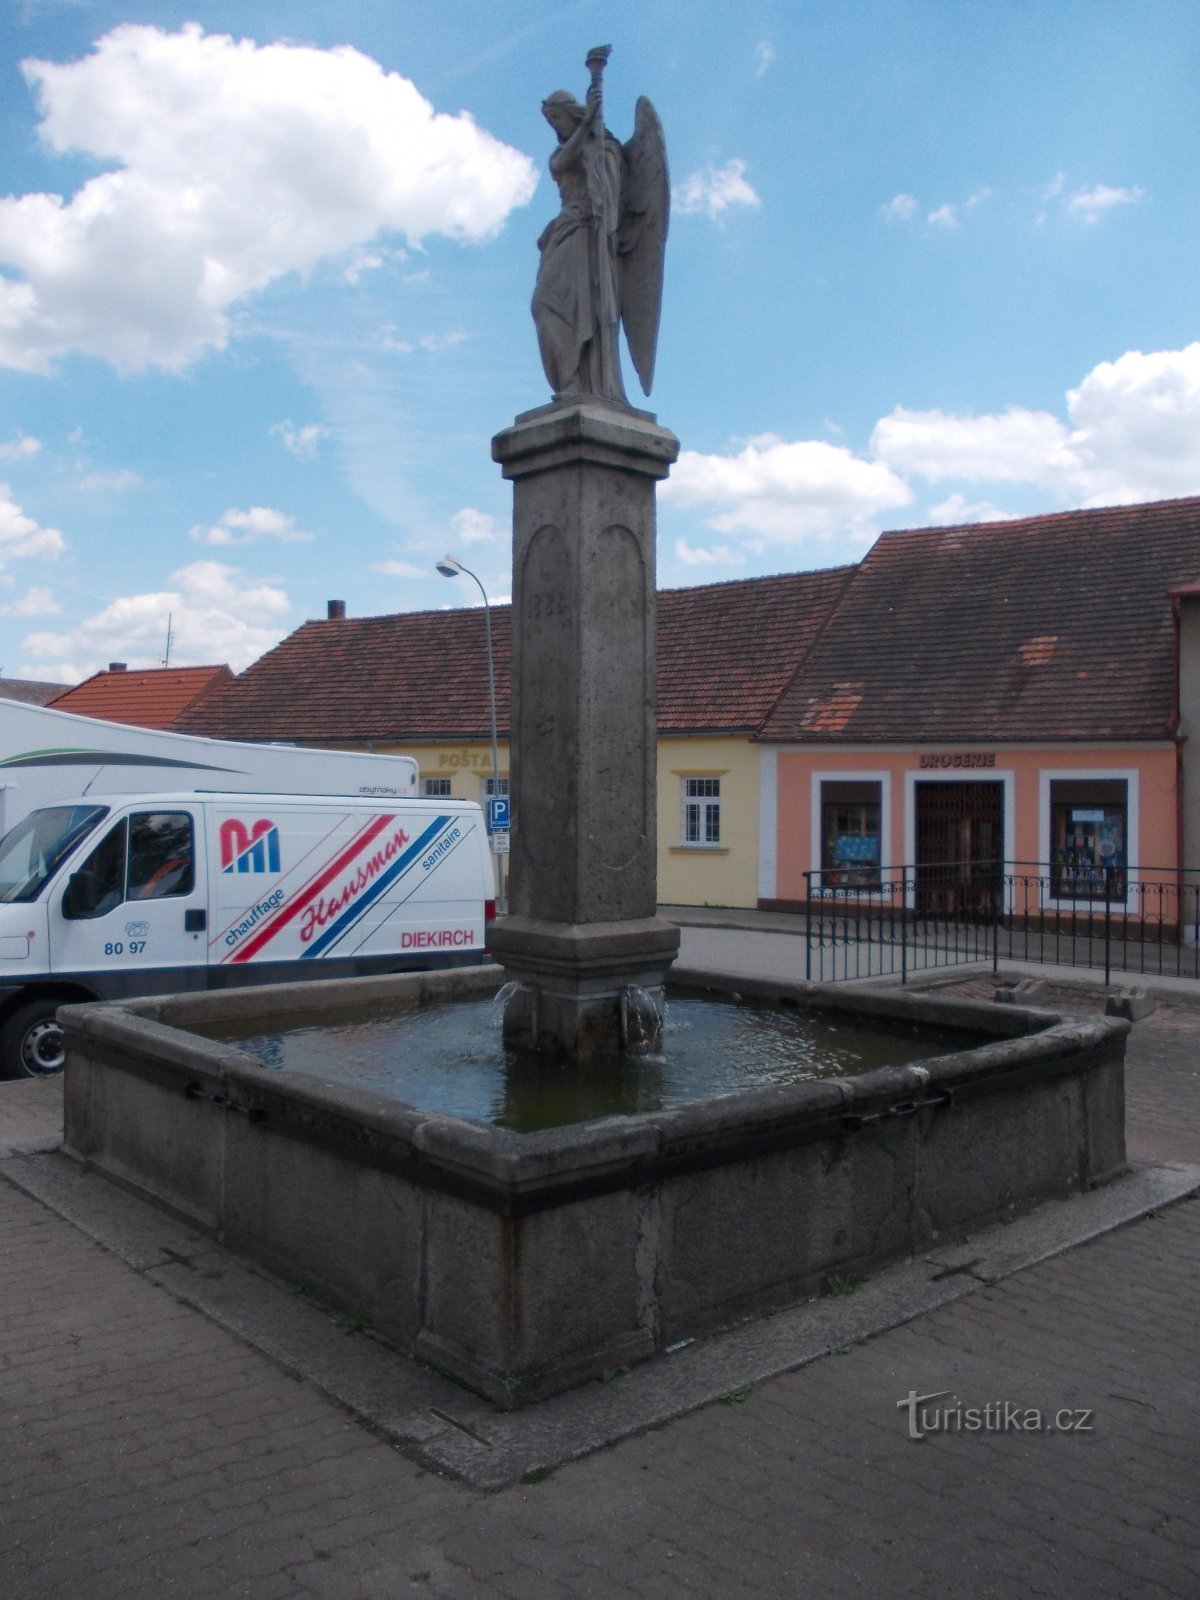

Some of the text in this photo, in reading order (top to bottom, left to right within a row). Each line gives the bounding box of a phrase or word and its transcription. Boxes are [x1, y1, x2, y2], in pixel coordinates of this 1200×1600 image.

[440, 750, 492, 767] POŠTA
[919, 752, 996, 769] DROGERIE
[494, 801, 506, 819] P
[422, 826, 461, 871] sanitaire
[300, 828, 411, 943] Hausman
[225, 888, 284, 946] chauffage
[401, 930, 474, 948] DIEKIRCH
[104, 941, 147, 956] 80 97
